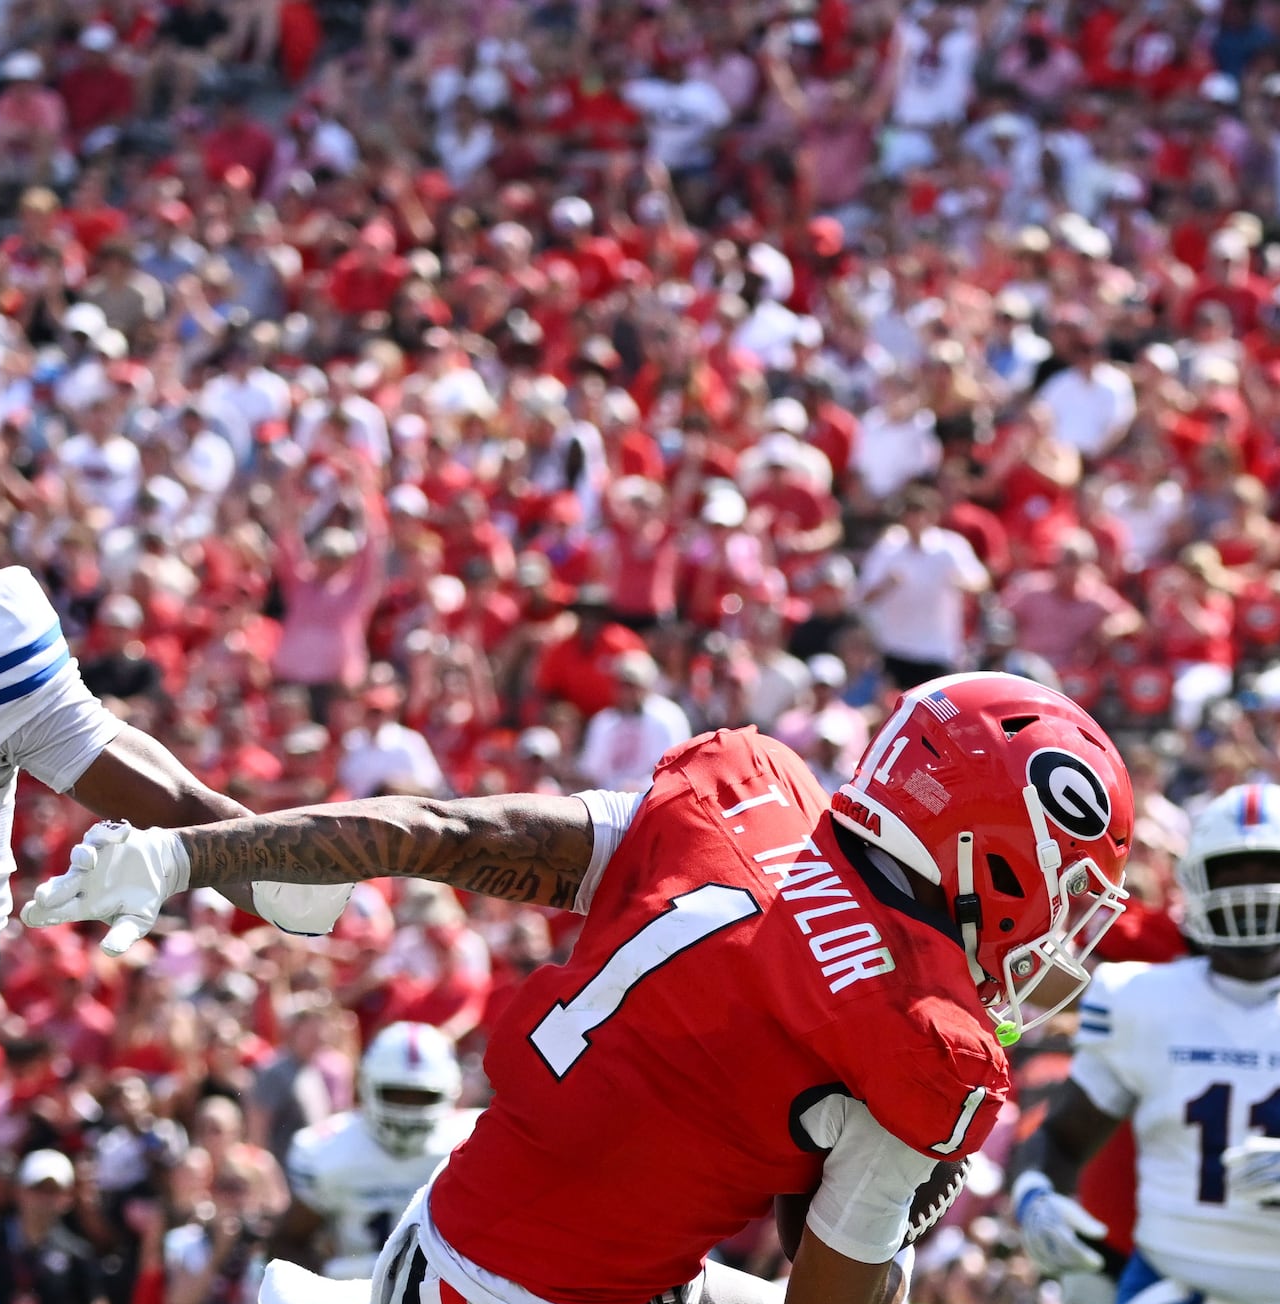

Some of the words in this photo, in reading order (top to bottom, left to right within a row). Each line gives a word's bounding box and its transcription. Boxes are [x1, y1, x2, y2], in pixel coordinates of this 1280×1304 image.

[872, 735, 910, 785] 1
[1026, 746, 1111, 841] G
[721, 784, 791, 835] T.
[752, 833, 896, 995] TAYLOR
[528, 881, 765, 1082] 1
[929, 1084, 988, 1156] 1
